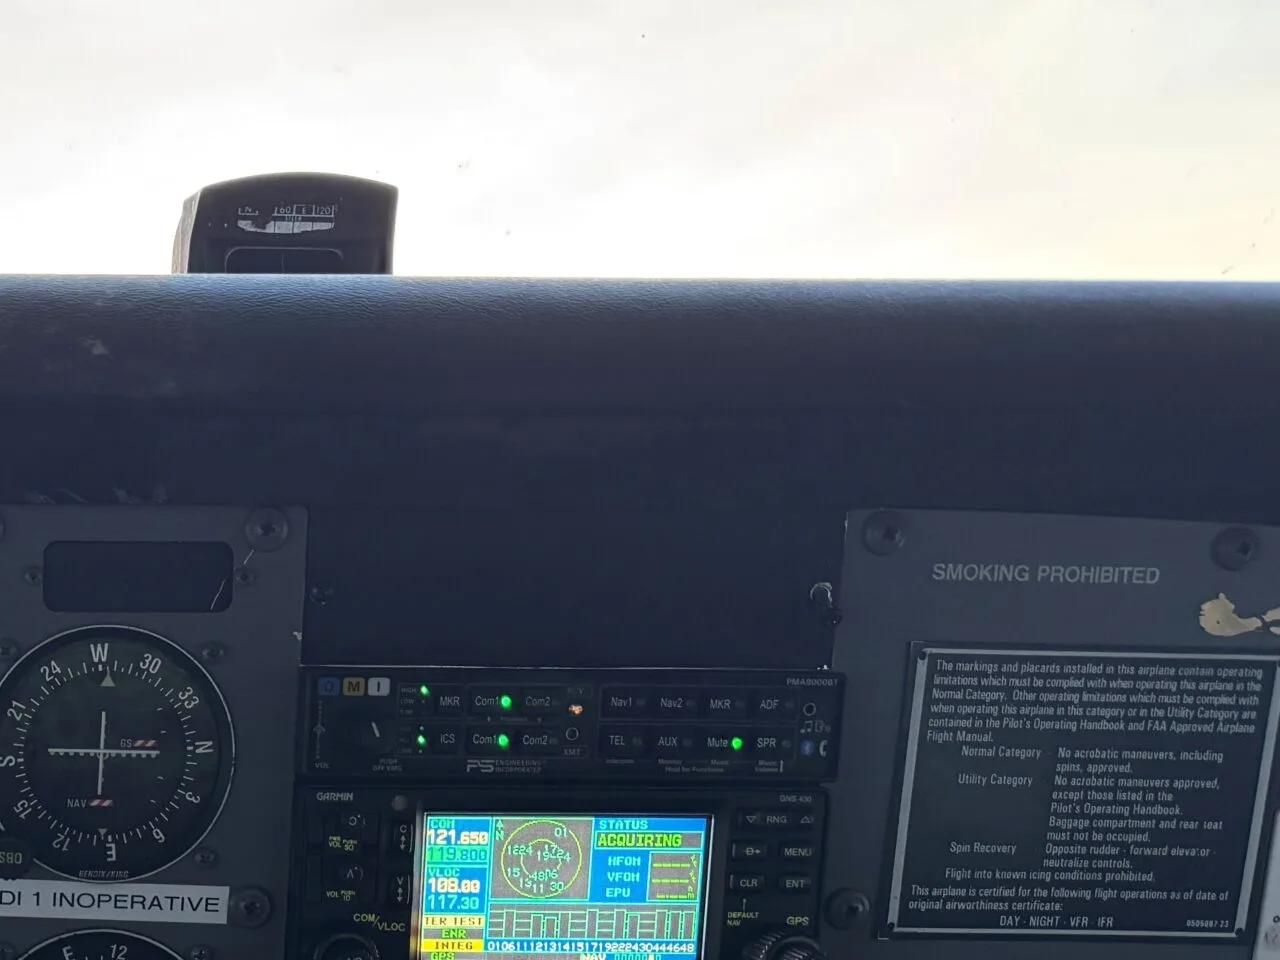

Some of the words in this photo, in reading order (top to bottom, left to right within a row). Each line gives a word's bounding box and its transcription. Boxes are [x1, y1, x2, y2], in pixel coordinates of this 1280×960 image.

[933, 563, 1029, 582] SMOKING
[1037, 567, 1160, 584] PROHIBITED
[611, 698, 632, 708] Nav1
[660, 698, 683, 709] Nav2
[710, 699, 731, 710] MKR
[760, 700, 778, 710] ADF
[523, 735, 548, 746] Com2
[609, 736, 626, 747] TEL
[658, 737, 677, 747] AUX
[707, 737, 728, 749] Mute
[757, 738, 776, 749] SPR
[962, 746, 996, 758] Normal
[999, 746, 1041, 760] Category
[958, 774, 987, 786] Utility
[990, 775, 1032, 788] Category
[317, 792, 353, 802] GARMIN
[599, 820, 648, 830] STATUS
[427, 830, 488, 845] 121.650
[598, 834, 682, 847] ACQUIRING
[784, 847, 812, 857] MENU
[950, 842, 970, 854] Spin
[974, 843, 1016, 855] Recovery
[427, 848, 487, 861] 119.800
[428, 868, 460, 877] VLOC
[945, 868, 971, 880] Flight
[974, 870, 992, 880] into
[995, 870, 1026, 880] known
[1029, 870, 1051, 882] icing
[1054, 871, 1102, 882] conditions
[1106, 871, 1155, 883] prohibited.
[429, 879, 480, 893] 108.00
[739, 878, 758, 888] CLR
[786, 879, 805, 889] ENT
[606, 888, 631, 898] EPU
[31, 891, 40, 907] 1
[53, 892, 219, 914] INOPERATIVE
[428, 895, 479, 909] 117.30
[787, 916, 809, 927] GPS
[1000, 916, 1020, 927] DAY
[1029, 916, 1060, 928] NIGHT
[1070, 917, 1088, 928] VFR
[1097, 917, 1114, 928] IFR
[443, 929, 466, 939] ENR
[436, 941, 473, 950] INTEG
